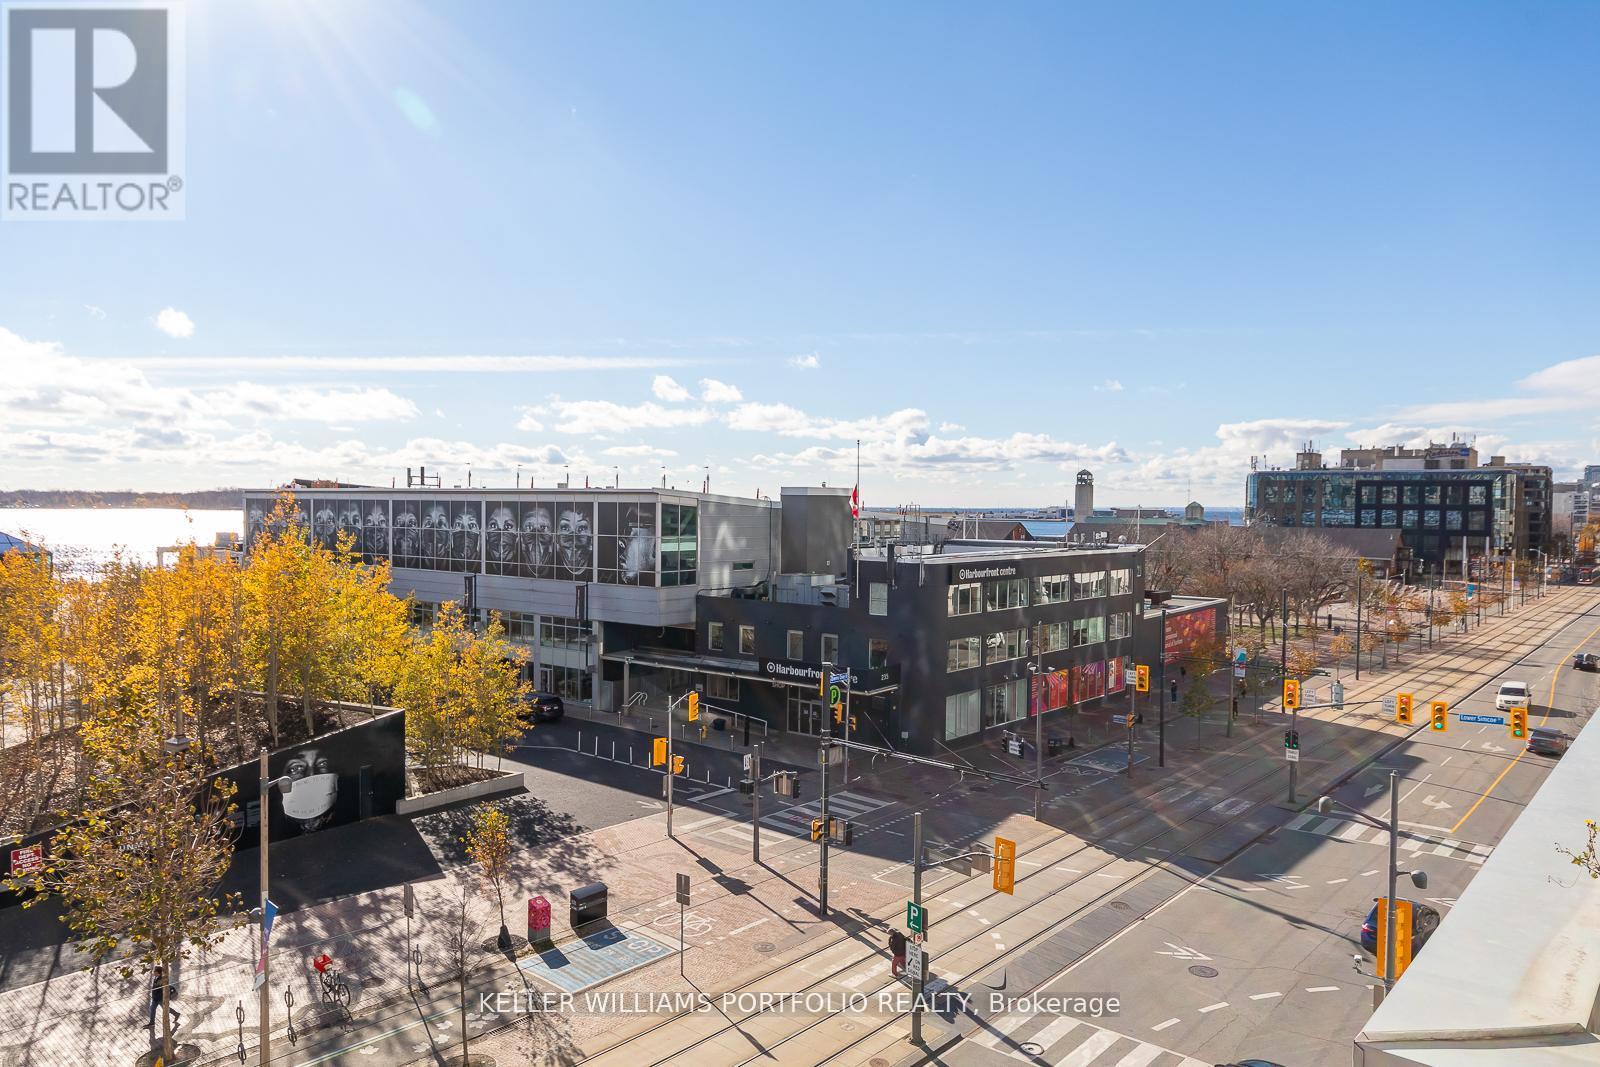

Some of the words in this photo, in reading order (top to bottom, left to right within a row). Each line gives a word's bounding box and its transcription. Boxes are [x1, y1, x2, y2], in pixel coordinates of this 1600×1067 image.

[966, 567, 999, 579] Harbourfront
[1000, 566, 1016, 576] centre
[776, 663, 823, 679] Harbourfro
[1477, 715, 1497, 723] Simcoe
[910, 906, 918, 920] P
